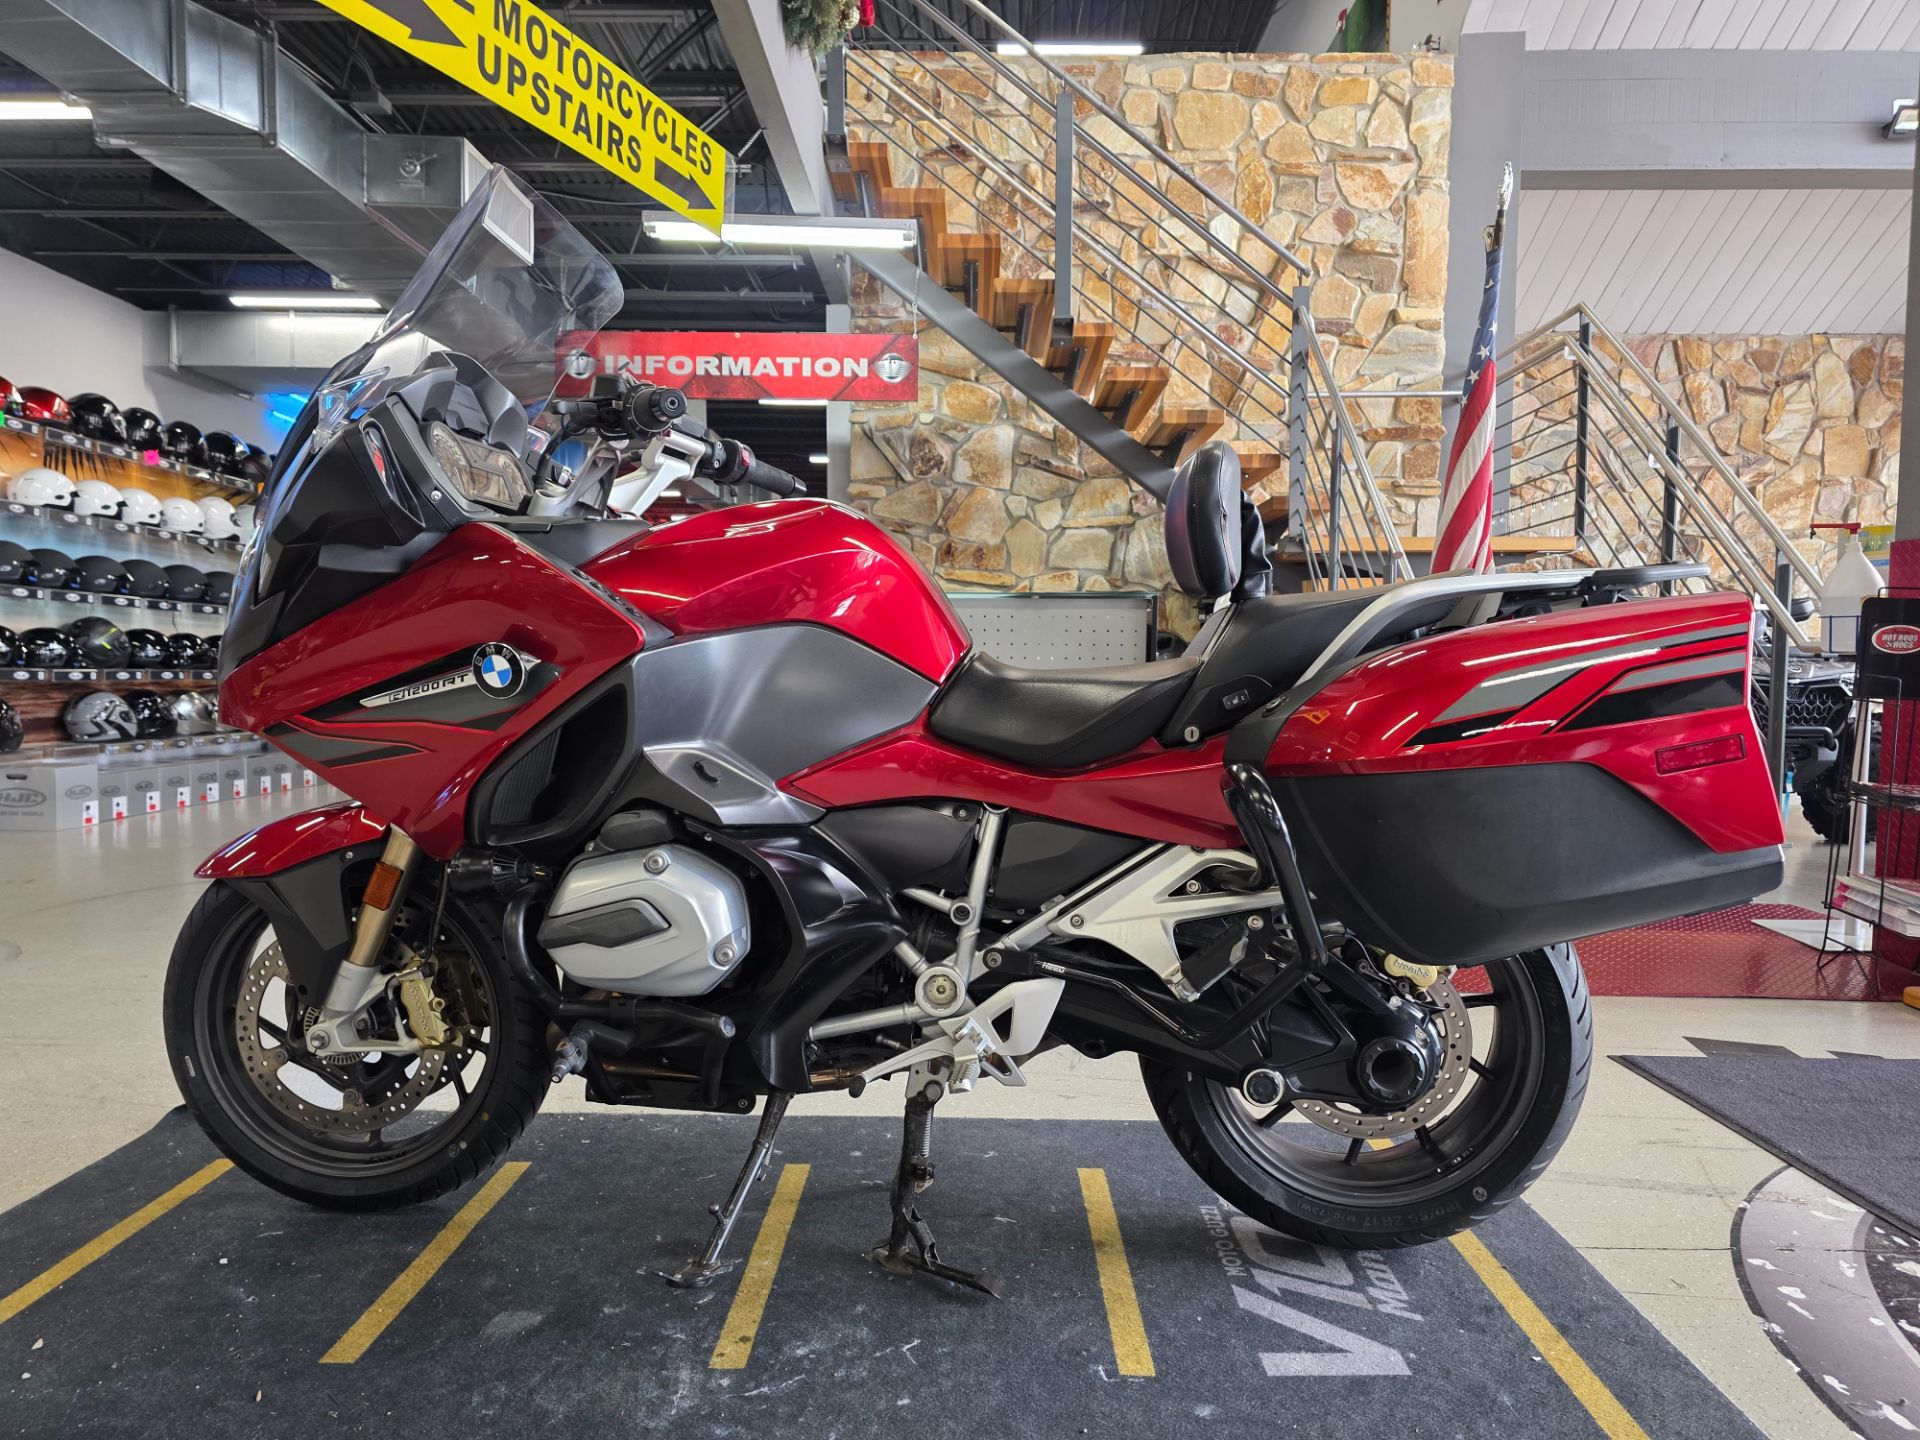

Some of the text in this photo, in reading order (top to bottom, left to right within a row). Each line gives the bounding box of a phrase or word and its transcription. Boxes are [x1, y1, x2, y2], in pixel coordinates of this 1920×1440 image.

[494, 0, 712, 176] MOTORCYCLES
[477, 33, 642, 174] UPSTAIRS
[603, 354, 869, 378] INFORMATION
[474, 643, 514, 667] BMW
[388, 673, 469, 702] R1200RT
[1394, 957, 1429, 978] brembo
[1200, 1205, 1247, 1277] MOTO GUZZI
